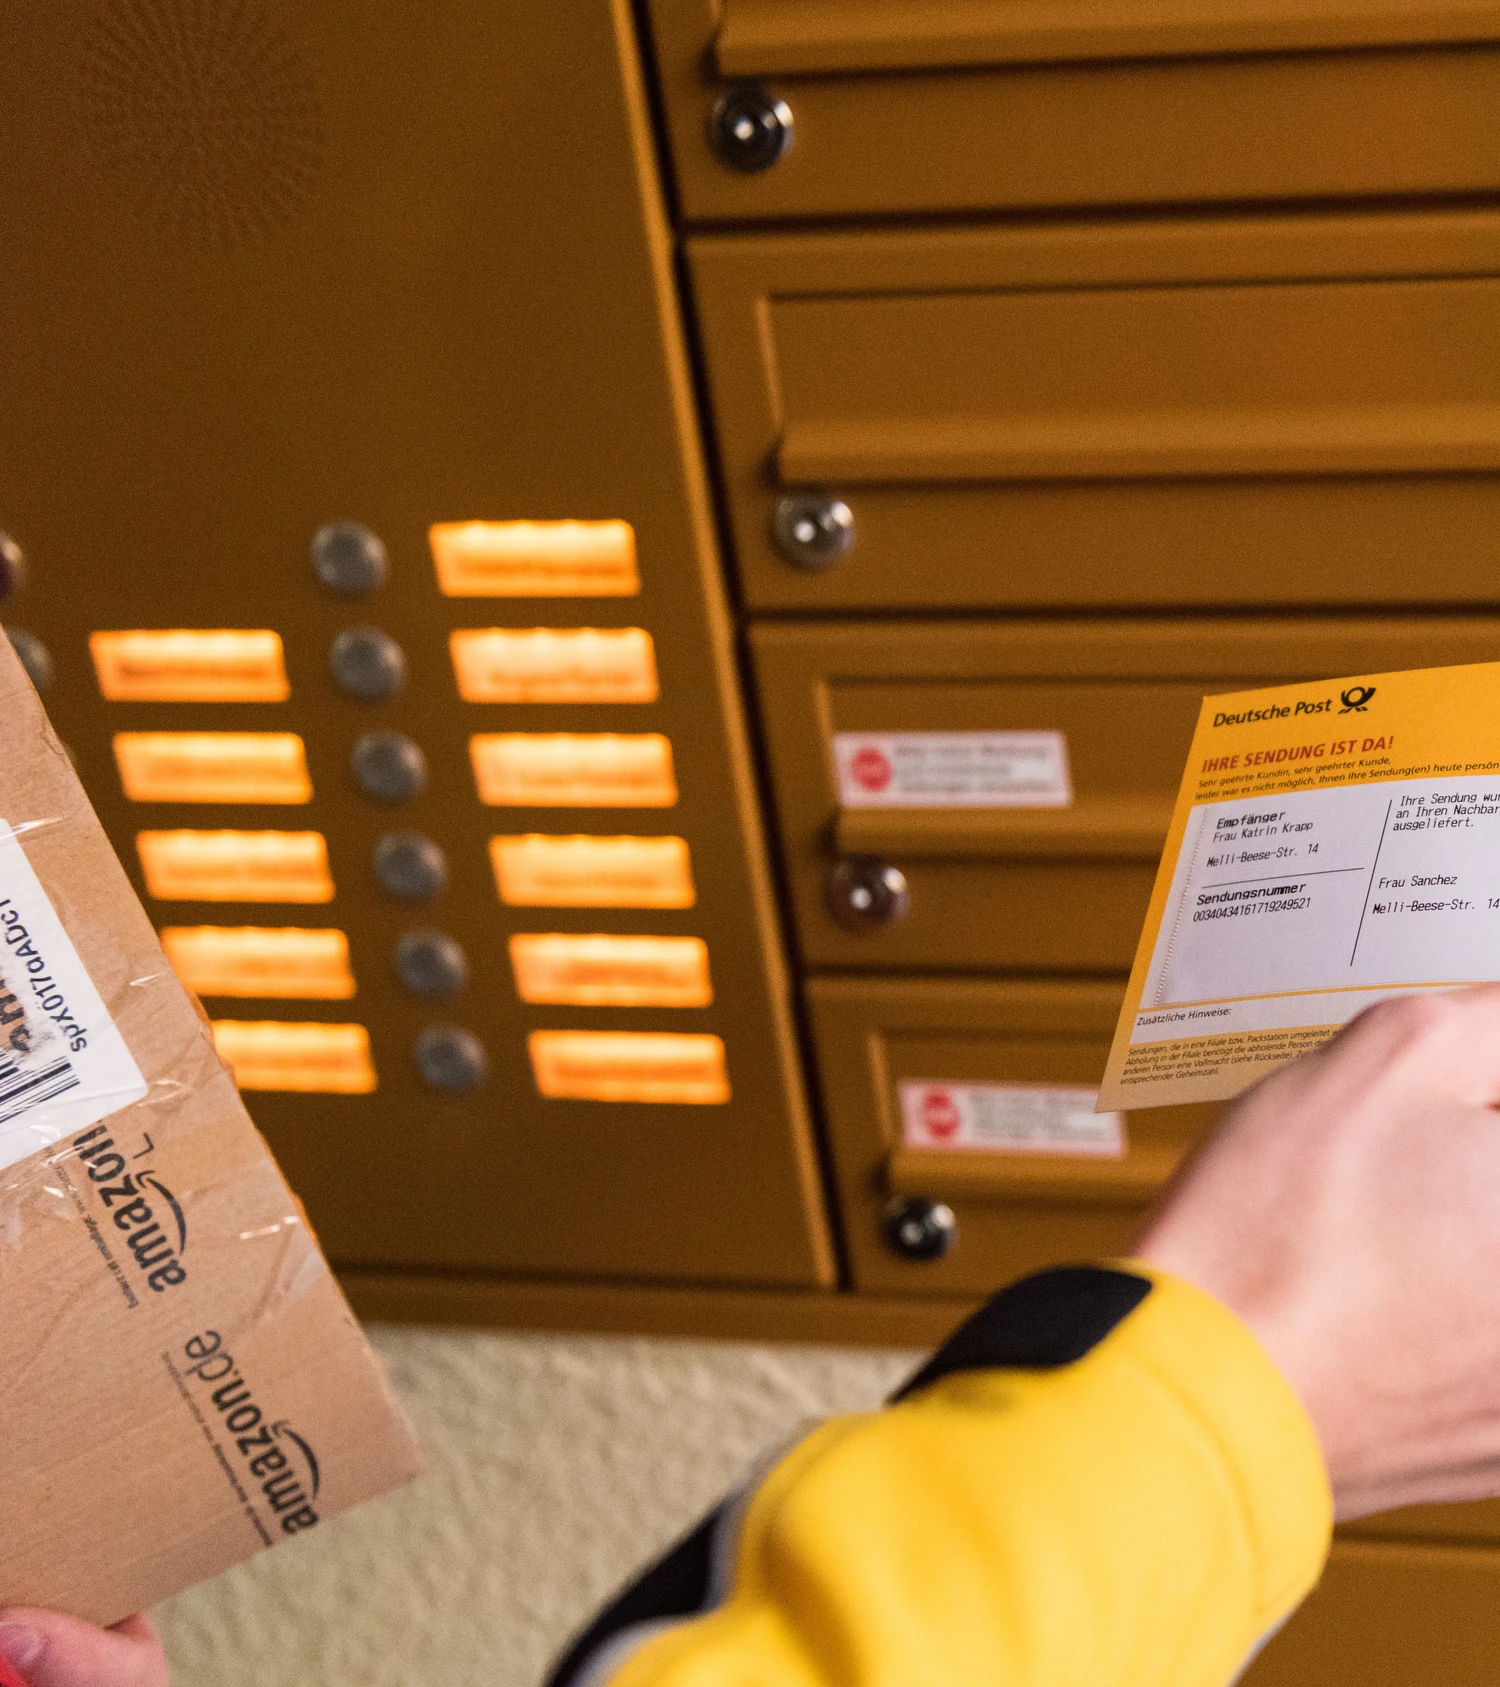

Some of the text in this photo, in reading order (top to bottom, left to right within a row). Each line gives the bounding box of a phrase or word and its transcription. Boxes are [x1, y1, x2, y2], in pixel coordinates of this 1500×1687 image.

[1213, 699, 1332, 727] Deutsche Post
[1202, 735, 1394, 773] IHRE SENDUNG IST DA!
[1195, 789, 1220, 800] leider
[1222, 787, 1239, 796] war
[1252, 781, 1275, 792] nicht
[1277, 777, 1315, 790] möglich,
[1319, 773, 1346, 783] Ihnen
[1347, 770, 1367, 780] Ihre
[1369, 764, 1431, 779] Sendung(en)
[1433, 761, 1463, 772] heute
[1198, 756, 1392, 788] Sehr geehrte Kundin, sehr geehrter Kunde,
[1400, 795, 1425, 807] Ihre
[1430, 792, 1477, 804] Sendung
[1217, 810, 1286, 829] Empfänger
[1396, 808, 1409, 819] an
[1416, 805, 1448, 817] Ihren
[1212, 820, 1313, 843] Frau Katrin Krapp
[1392, 817, 1474, 831] ausgeliefert.
[1206, 843, 1319, 867] Melli-Beese-Str. 14
[1379, 874, 1458, 889] Frau Sanchez
[1196, 882, 1306, 906] Sendungsnummer
[1193, 897, 1311, 923] 00340434161719249521
[1372, 898, 1500, 914] Melli-Beese-Str. 14
[1137, 1007, 1232, 1026] Zusätzliche Hinweise:
[1170, 1043, 1181, 1051] die
[1190, 1041, 1206, 1049] eine
[1207, 1038, 1227, 1047] Filiale
[1228, 1037, 1245, 1045] bzw.
[1247, 1032, 1288, 1043] Packstation
[1290, 1029, 1330, 1040] umgeleitet
[1125, 1056, 1159, 1066] Abholung
[1168, 1052, 1181, 1060] der
[1182, 1050, 1201, 1059] Filiale
[1203, 1047, 1233, 1057] benötigt
[1234, 1046, 1246, 1054] die
[1247, 1042, 1286, 1053] abholende
[1287, 1039, 1313, 1049] Person
[1122, 1065, 1151, 1076] anderen
[1152, 1062, 1175, 1072] Person
[1176, 1061, 1192, 1069] eine
[1194, 1057, 1230, 1067] Vollmacht
[1231, 1054, 1251, 1064] (siehe
[1120, 1073, 1174, 1086] entsprechender
[73, 1125, 187, 1292] amazon
[184, 1330, 318, 1534] amazon.de
